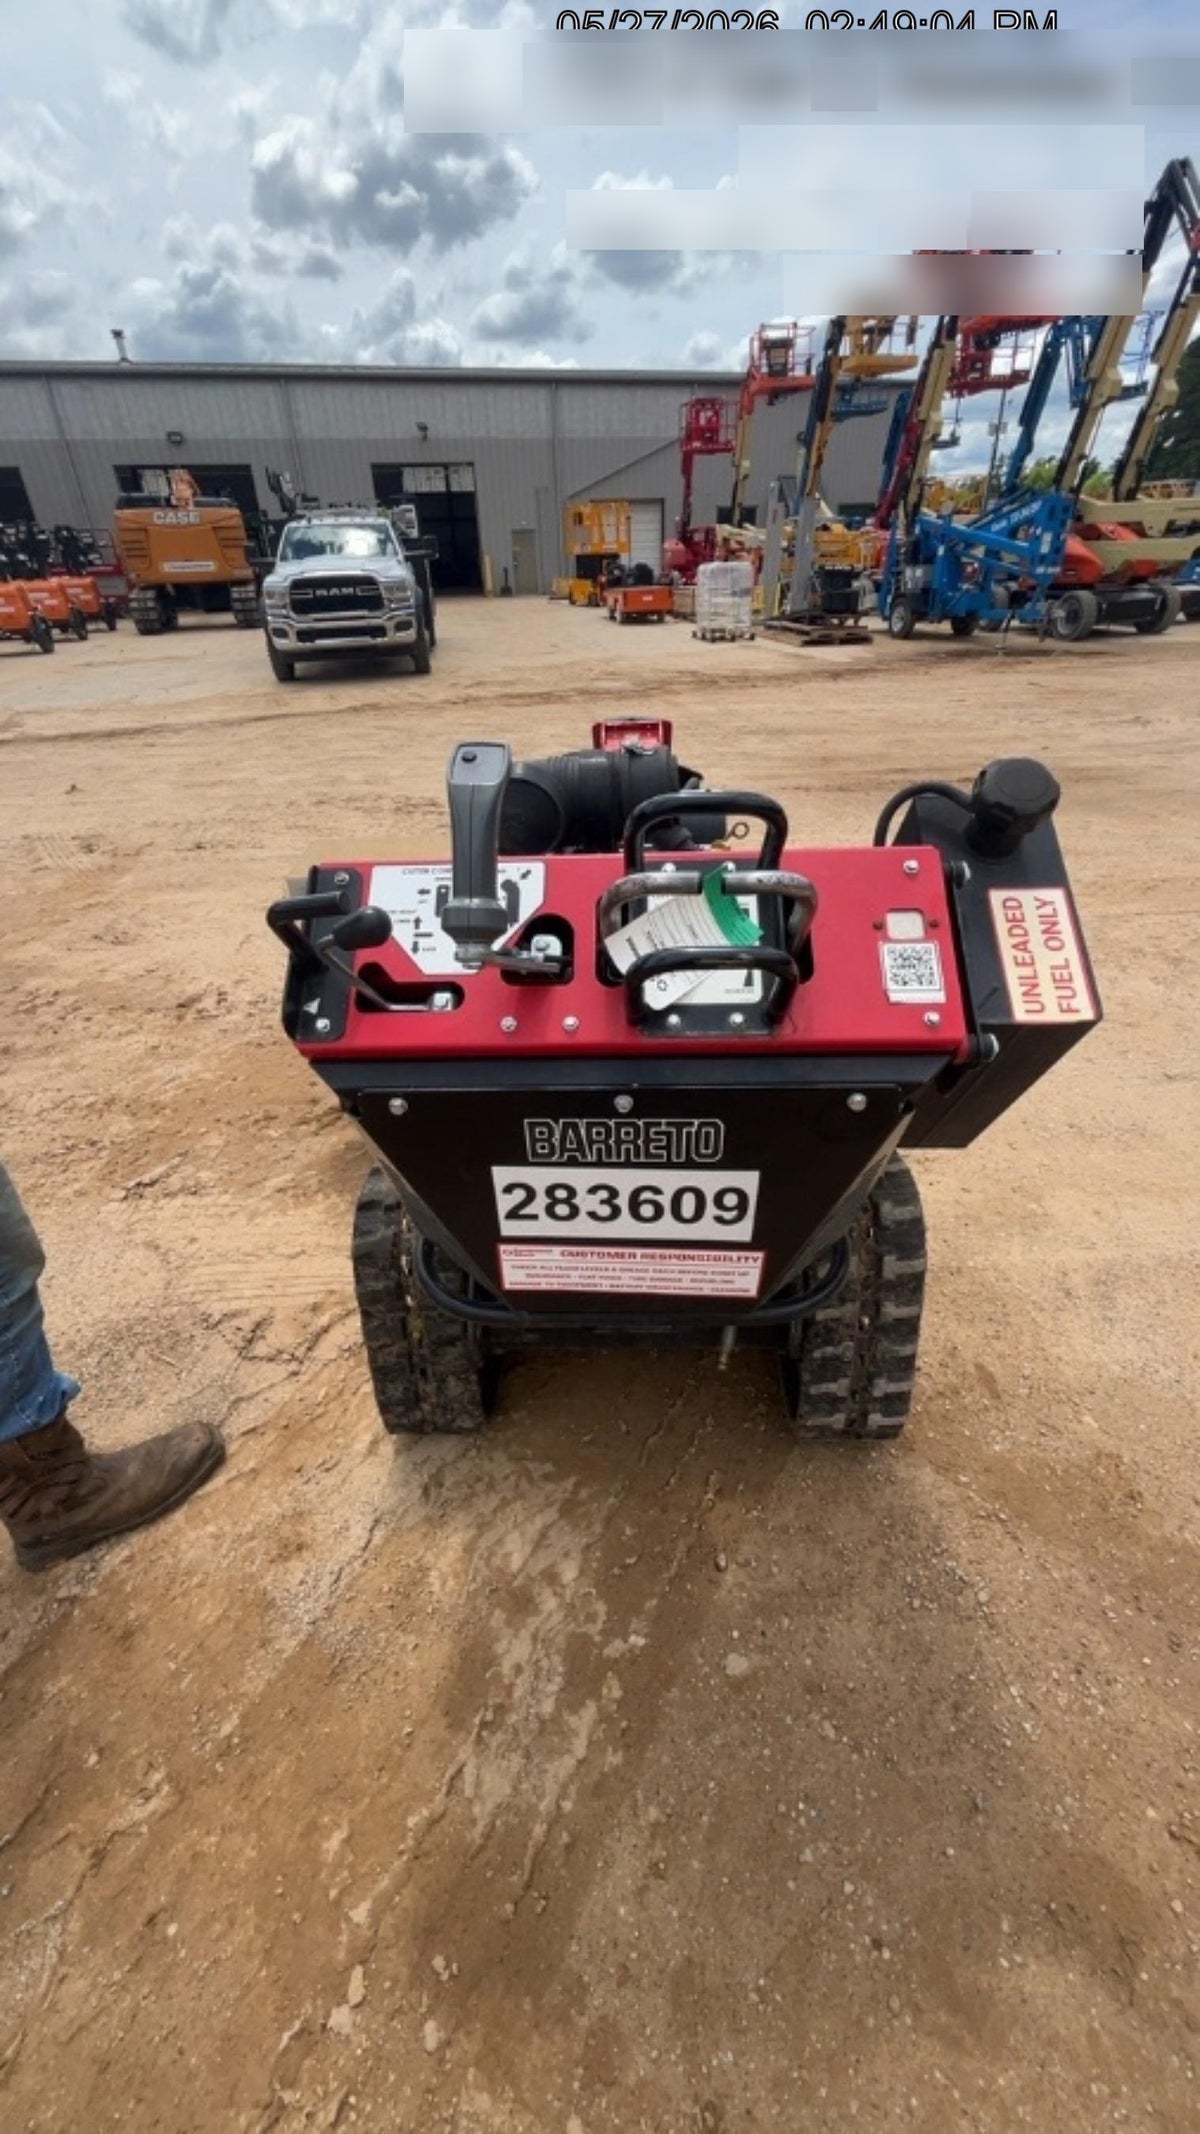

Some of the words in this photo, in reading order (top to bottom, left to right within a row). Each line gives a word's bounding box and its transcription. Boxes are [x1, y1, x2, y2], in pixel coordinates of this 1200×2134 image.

[153, 511, 201, 525] CASE
[315, 587, 355, 597] RAM
[1033, 896, 1066, 952] ONLY
[1002, 896, 1046, 1015] UNLEADED
[1050, 957, 1081, 1014] FUEL
[523, 1118, 725, 1163] BARRETO
[502, 1182, 750, 1226] 283609
[561, 1248, 638, 1260] CUSTOMER
[641, 1251, 761, 1263] RESPONSIBILITY
